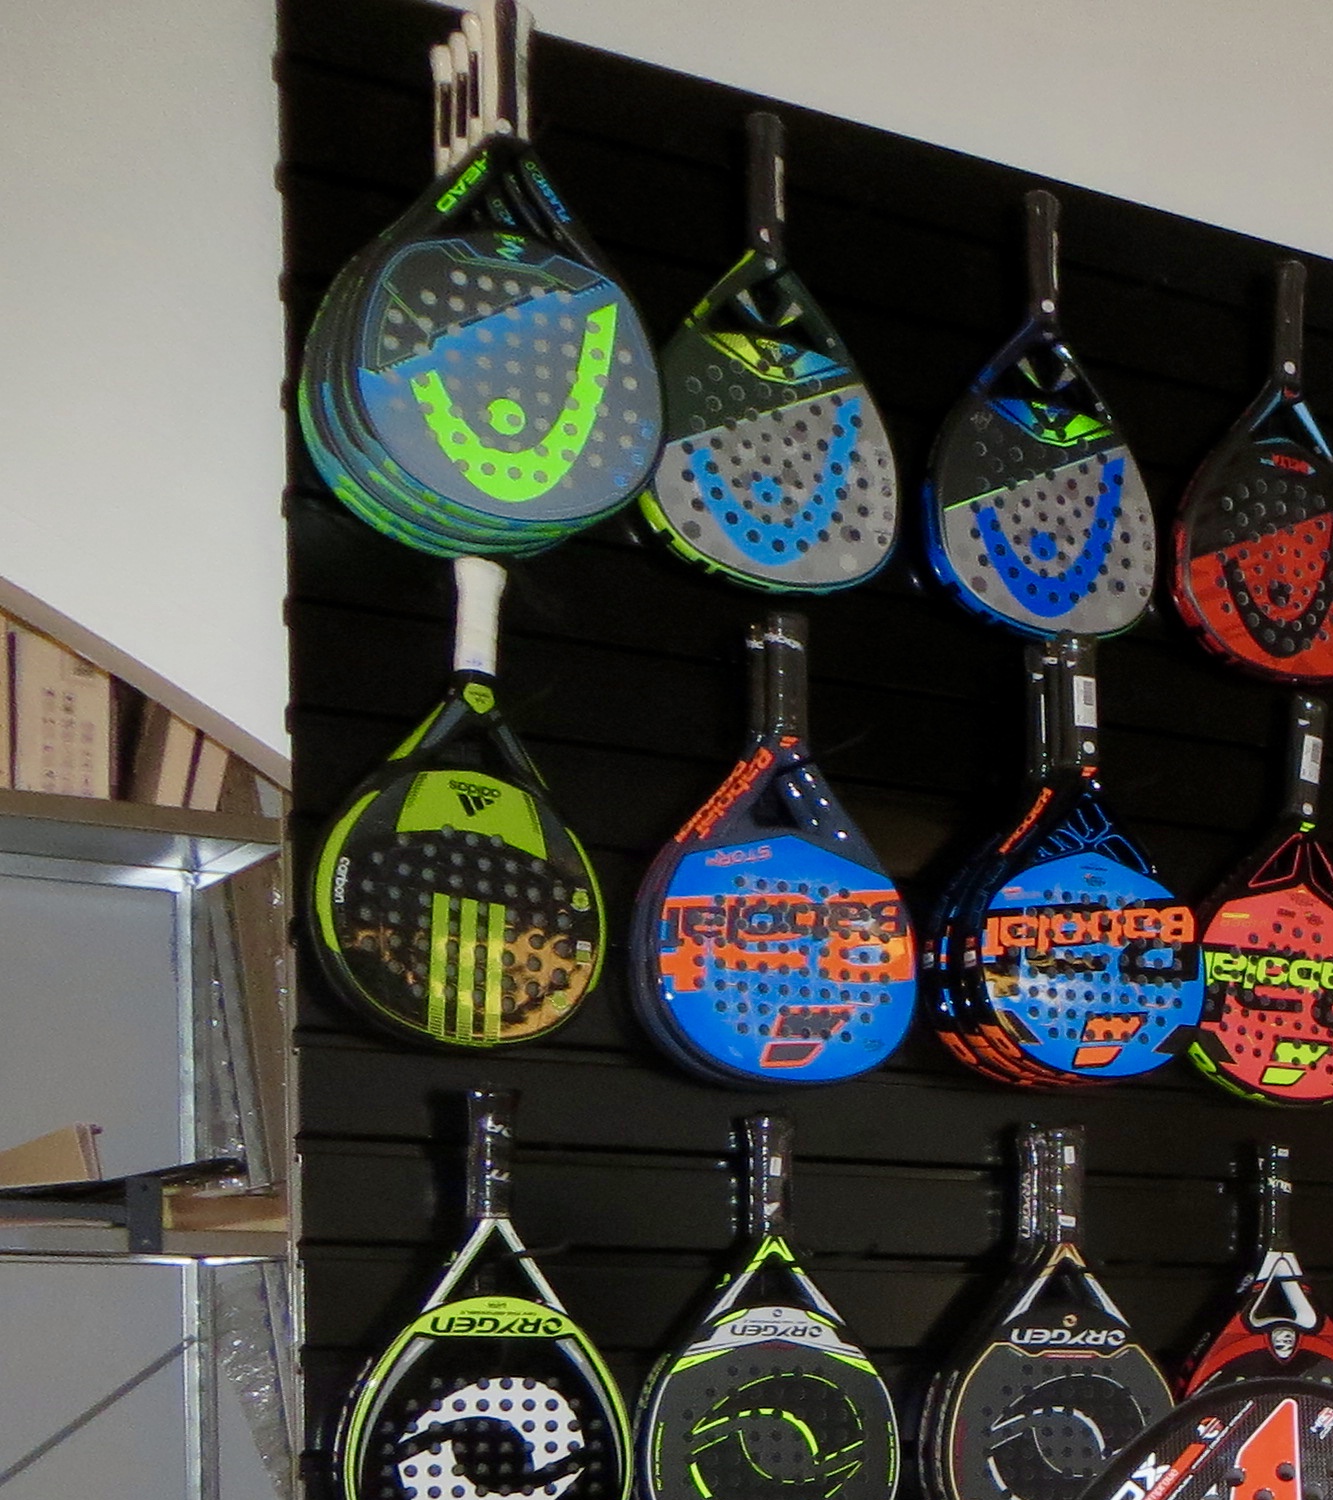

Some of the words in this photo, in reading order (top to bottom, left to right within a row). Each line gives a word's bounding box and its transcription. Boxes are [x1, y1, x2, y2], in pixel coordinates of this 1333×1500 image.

[334, 856, 351, 905] carbon
[704, 845, 773, 867] STORM
[662, 898, 908, 949] Babolat
[981, 904, 1196, 956] Babolat
